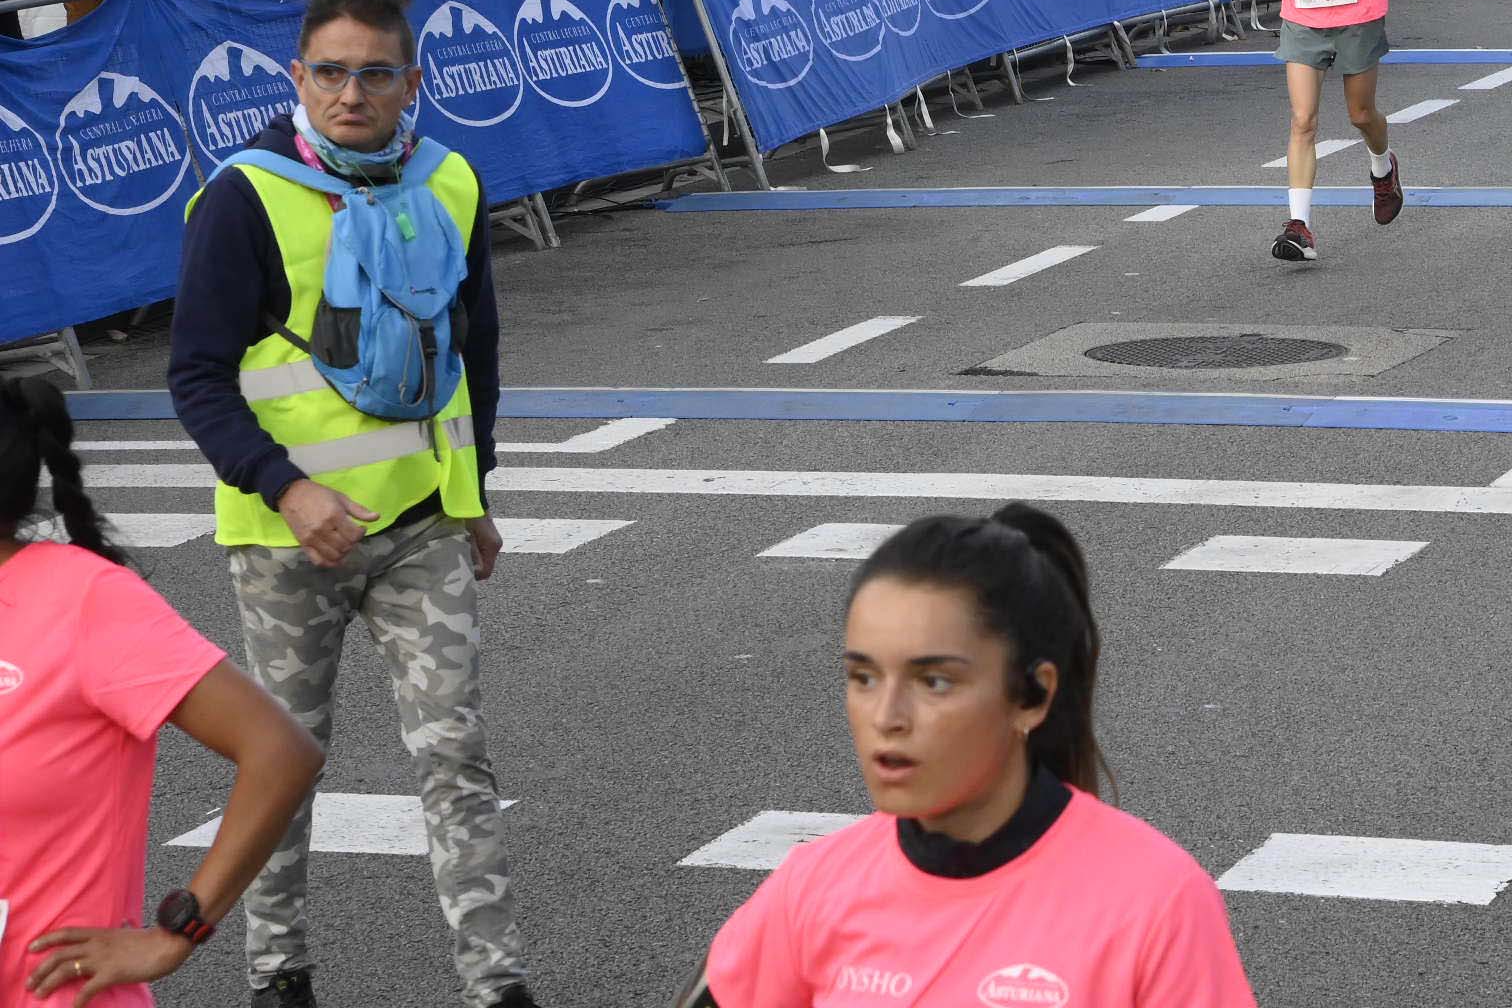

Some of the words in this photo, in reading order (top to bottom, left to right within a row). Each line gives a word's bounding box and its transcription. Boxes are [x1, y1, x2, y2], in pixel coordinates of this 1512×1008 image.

[625, 14, 658, 29] CENTRAL
[530, 30, 561, 44] CENTRAL
[561, 25, 591, 40] LECHERA
[616, 22, 675, 65] ASTUR
[437, 43, 470, 60] CENTRAL
[471, 38, 504, 55] LECHERA
[522, 36, 609, 83] ASTURIANA
[427, 50, 519, 101] ASTURIANA
[212, 89, 252, 106] CENTRAL
[253, 79, 289, 98] LECHERA
[79, 121, 123, 142] CENTRAL
